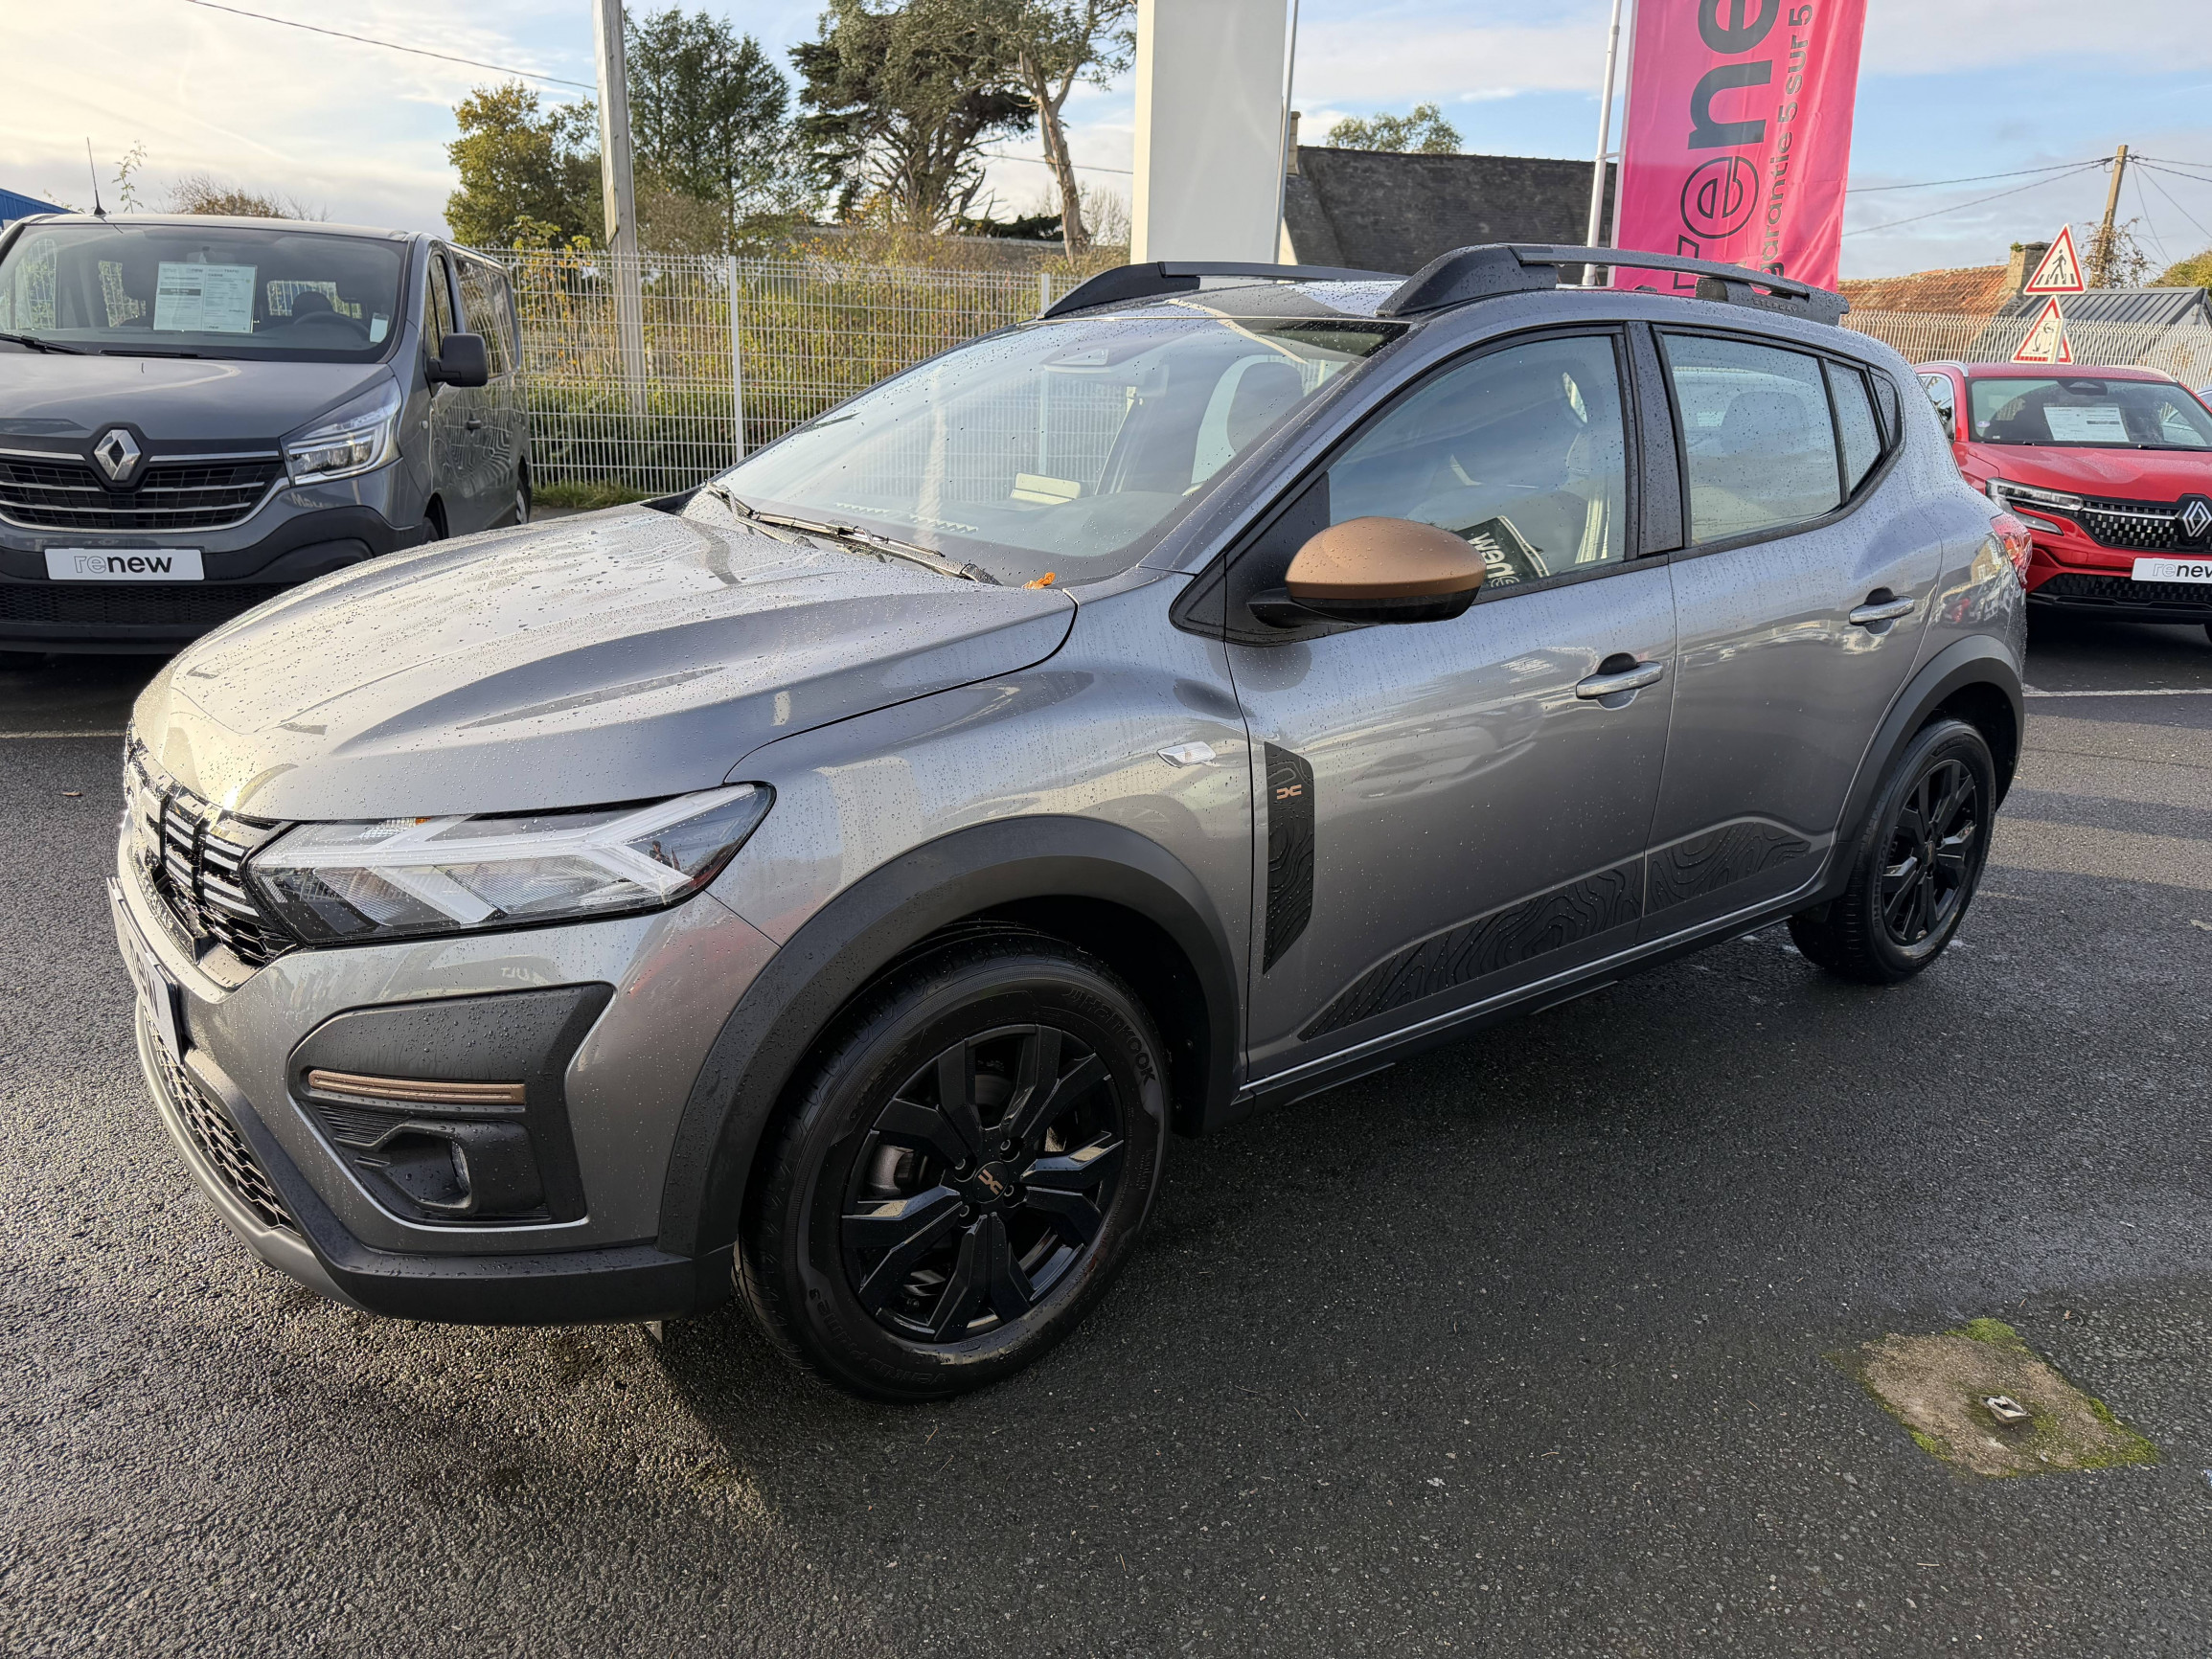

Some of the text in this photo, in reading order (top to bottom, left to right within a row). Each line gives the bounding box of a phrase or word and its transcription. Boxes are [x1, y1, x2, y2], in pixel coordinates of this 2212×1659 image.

[1788, 4, 1813, 27] 5
[1786, 34, 1809, 95] sur
[1777, 102, 1798, 123] 5
[1752, 298, 1798, 313] STEPWAY
[74, 556, 172, 574] renew
